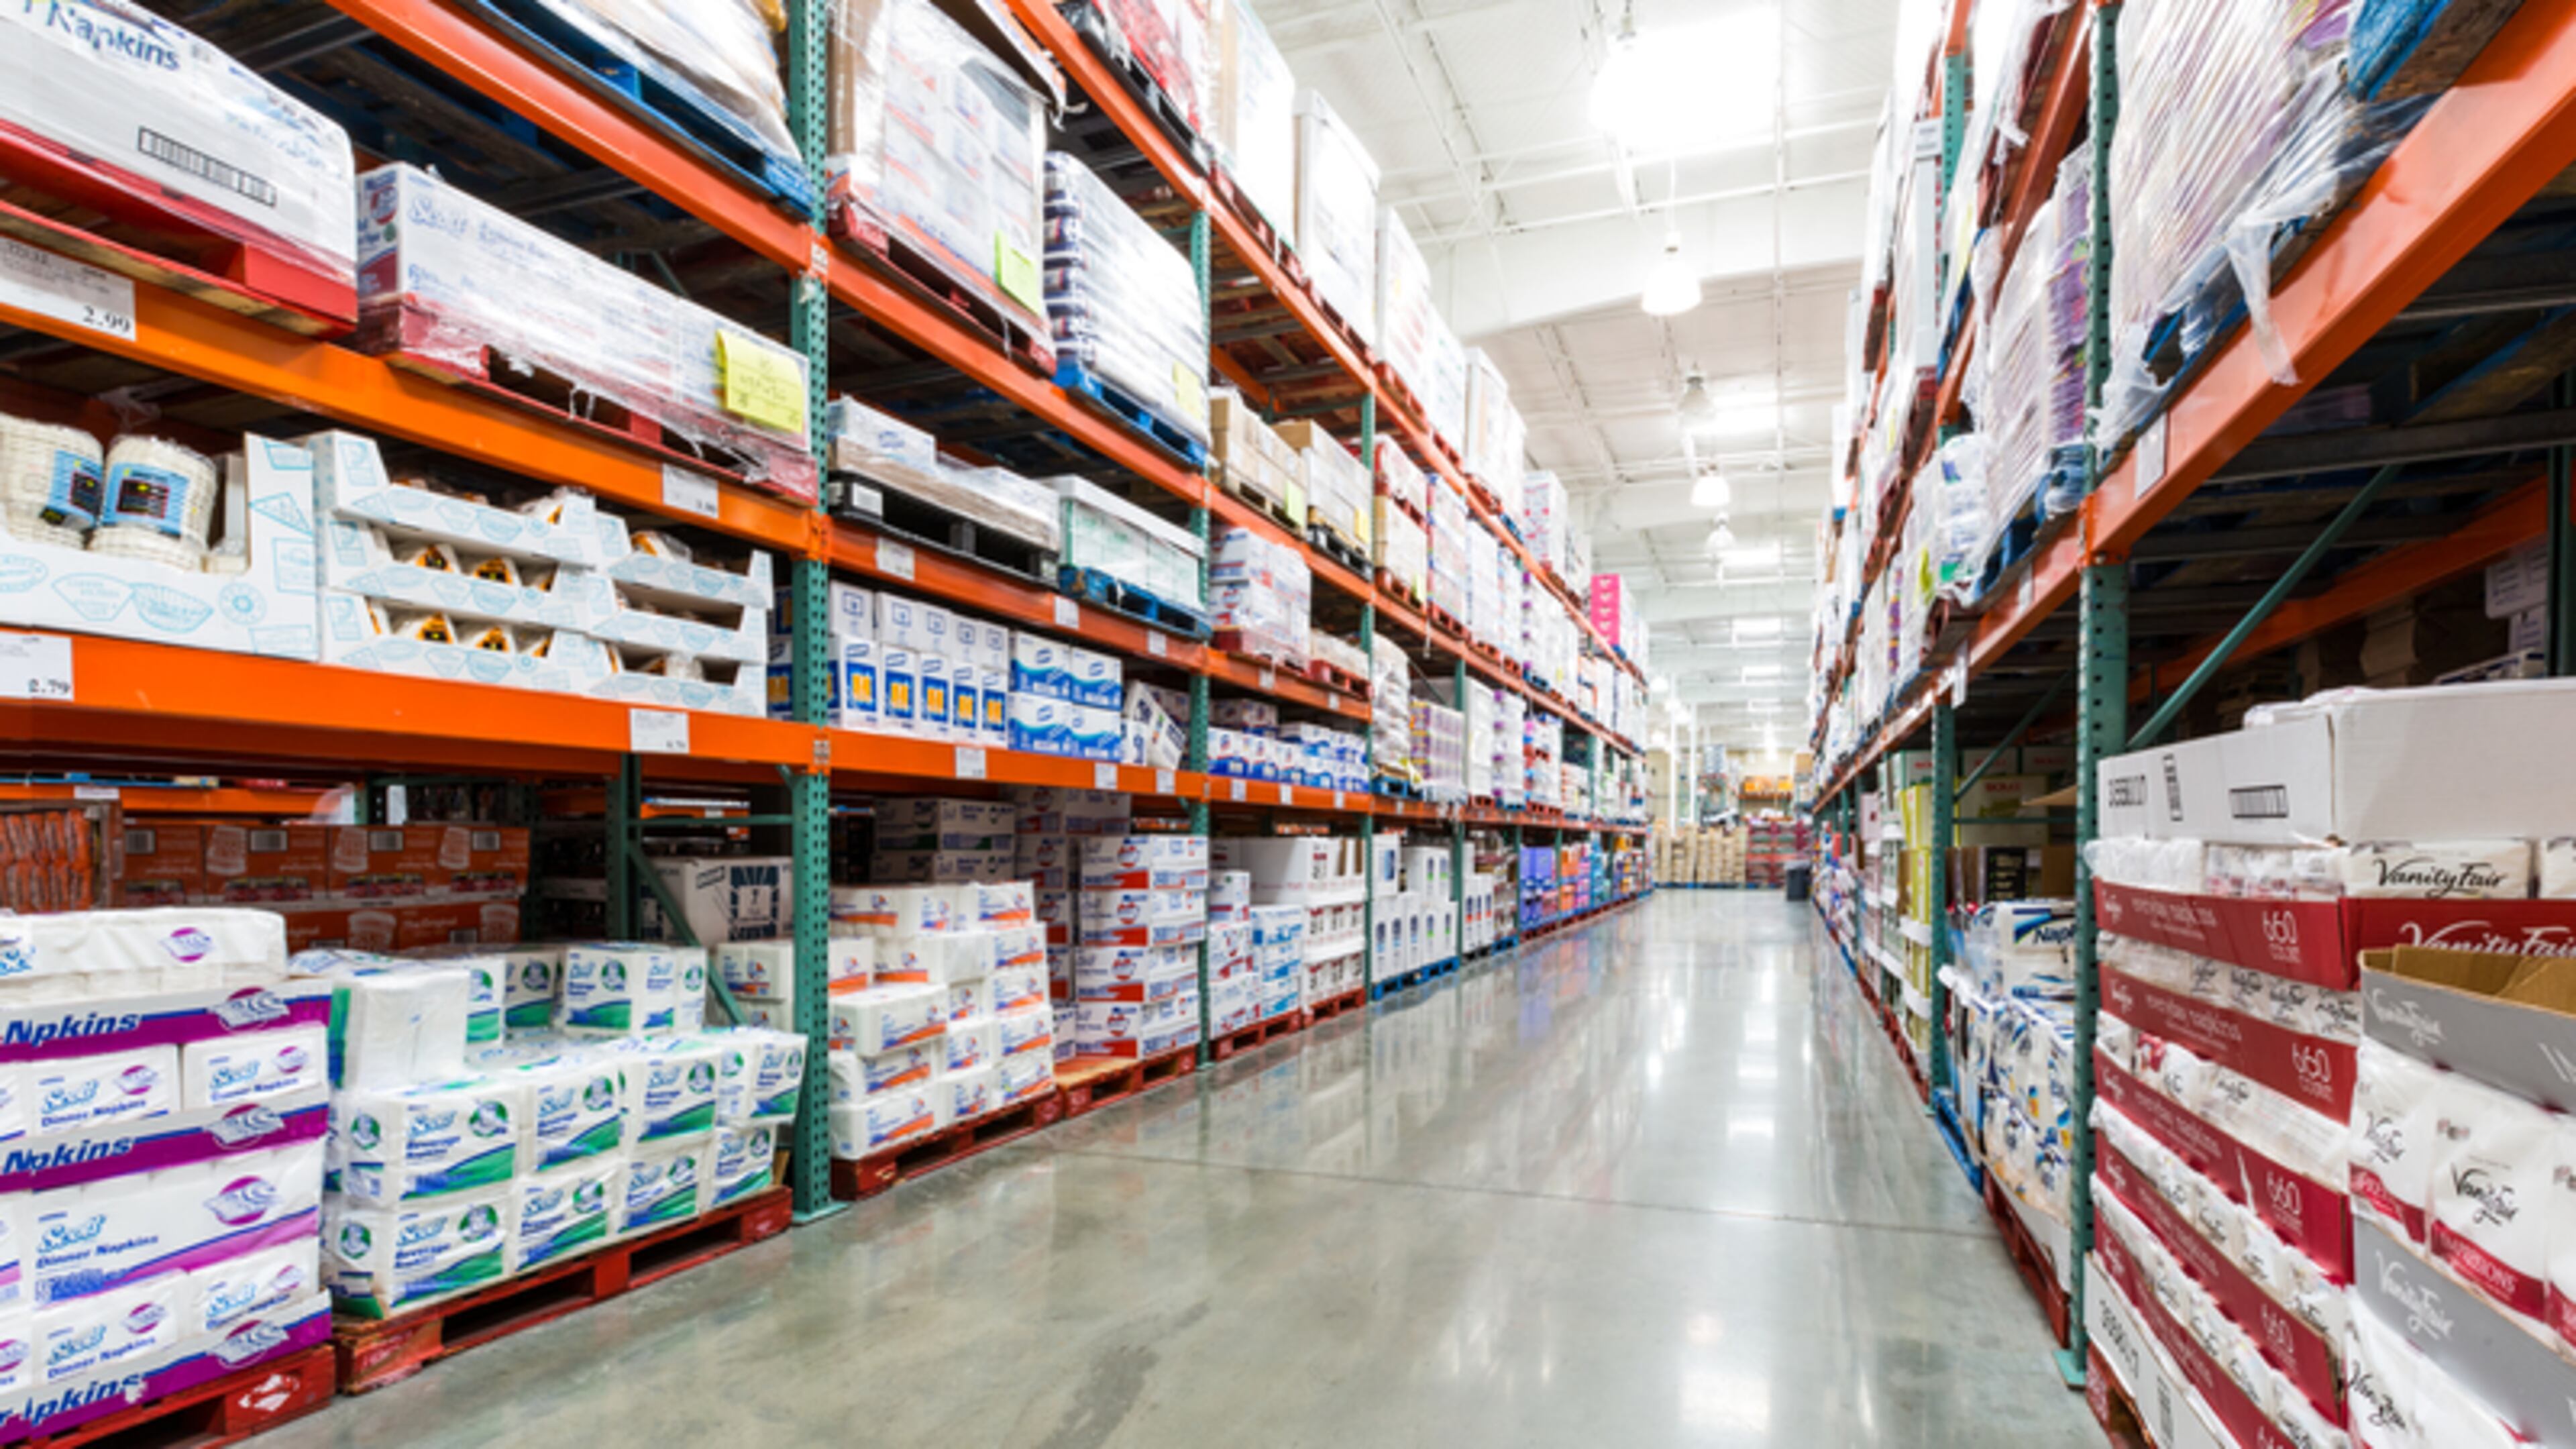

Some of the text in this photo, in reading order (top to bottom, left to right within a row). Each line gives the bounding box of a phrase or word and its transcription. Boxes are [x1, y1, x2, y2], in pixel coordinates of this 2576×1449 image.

[83, 304, 131, 331] 2.99
[2373, 855, 2508, 898] Vanity Fair
[2263, 910, 2298, 945] 660
[2520, 926, 2576, 957] Fai
[2291, 1042, 2330, 1083] 660
[2266, 1171, 2302, 1216] 660
